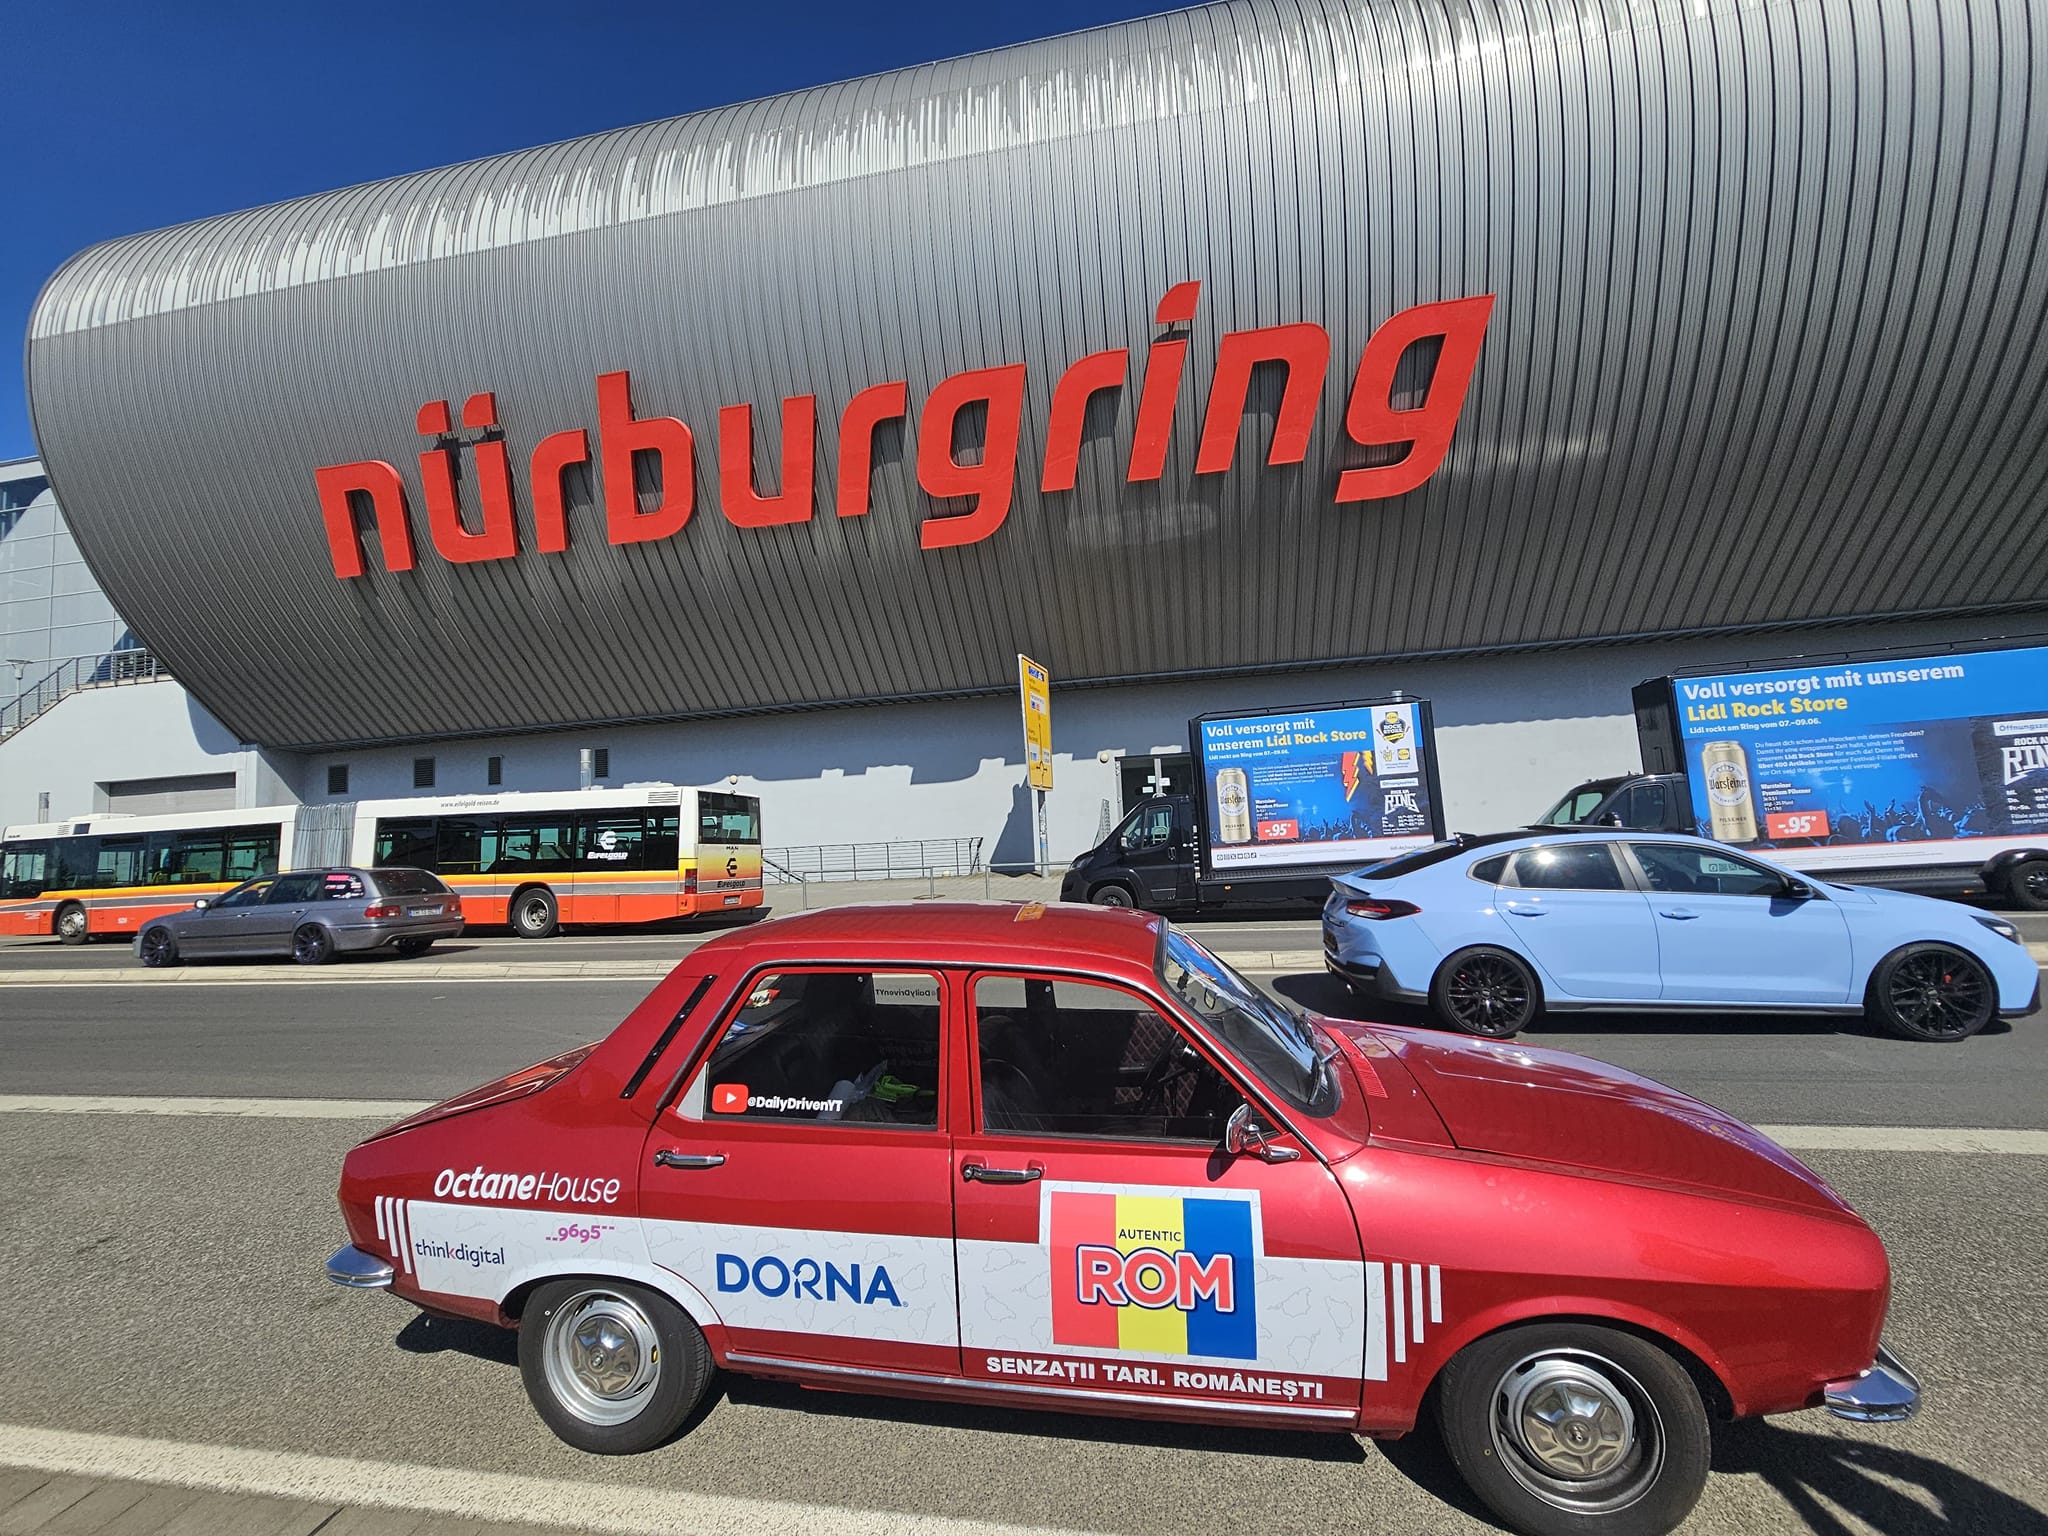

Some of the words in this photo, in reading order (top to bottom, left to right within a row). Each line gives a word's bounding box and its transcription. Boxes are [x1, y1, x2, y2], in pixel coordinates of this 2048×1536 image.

[315, 280, 1496, 579] nürburgring
[1683, 683, 1726, 701] Voll
[1729, 676, 1821, 698] versorgt
[1824, 670, 1863, 689] mit
[1867, 666, 1965, 685] unserem
[1687, 703, 1728, 722] Lidl
[1731, 699, 1787, 718] Rock
[1790, 695, 1848, 714] Store
[1206, 724, 1233, 737] Voll
[1234, 720, 1291, 735] versorgt
[1292, 718, 1316, 730] mit
[1689, 726, 1705, 735] Lidl
[1705, 725, 1726, 734] rockt
[1740, 722, 1760, 731] Ring
[1208, 739, 1264, 752] unserem
[1266, 734, 1292, 747] Lidl
[1294, 732, 1328, 745] Rock
[1330, 730, 1367, 742] Store
[2014, 737, 2040, 746] ROCK
[1709, 776, 1747, 790] Warsteiner
[1384, 793, 1420, 815] RING
[747, 1096, 843, 1112] @DailyDrivenYT
[434, 1166, 620, 1204] OctaneHouse
[1118, 1228, 1182, 1242] AUTENTIC
[415, 1239, 505, 1268] thinkdigital
[1076, 1244, 1235, 1314] ROM
[1102, 1364, 1166, 1386] TARI.
